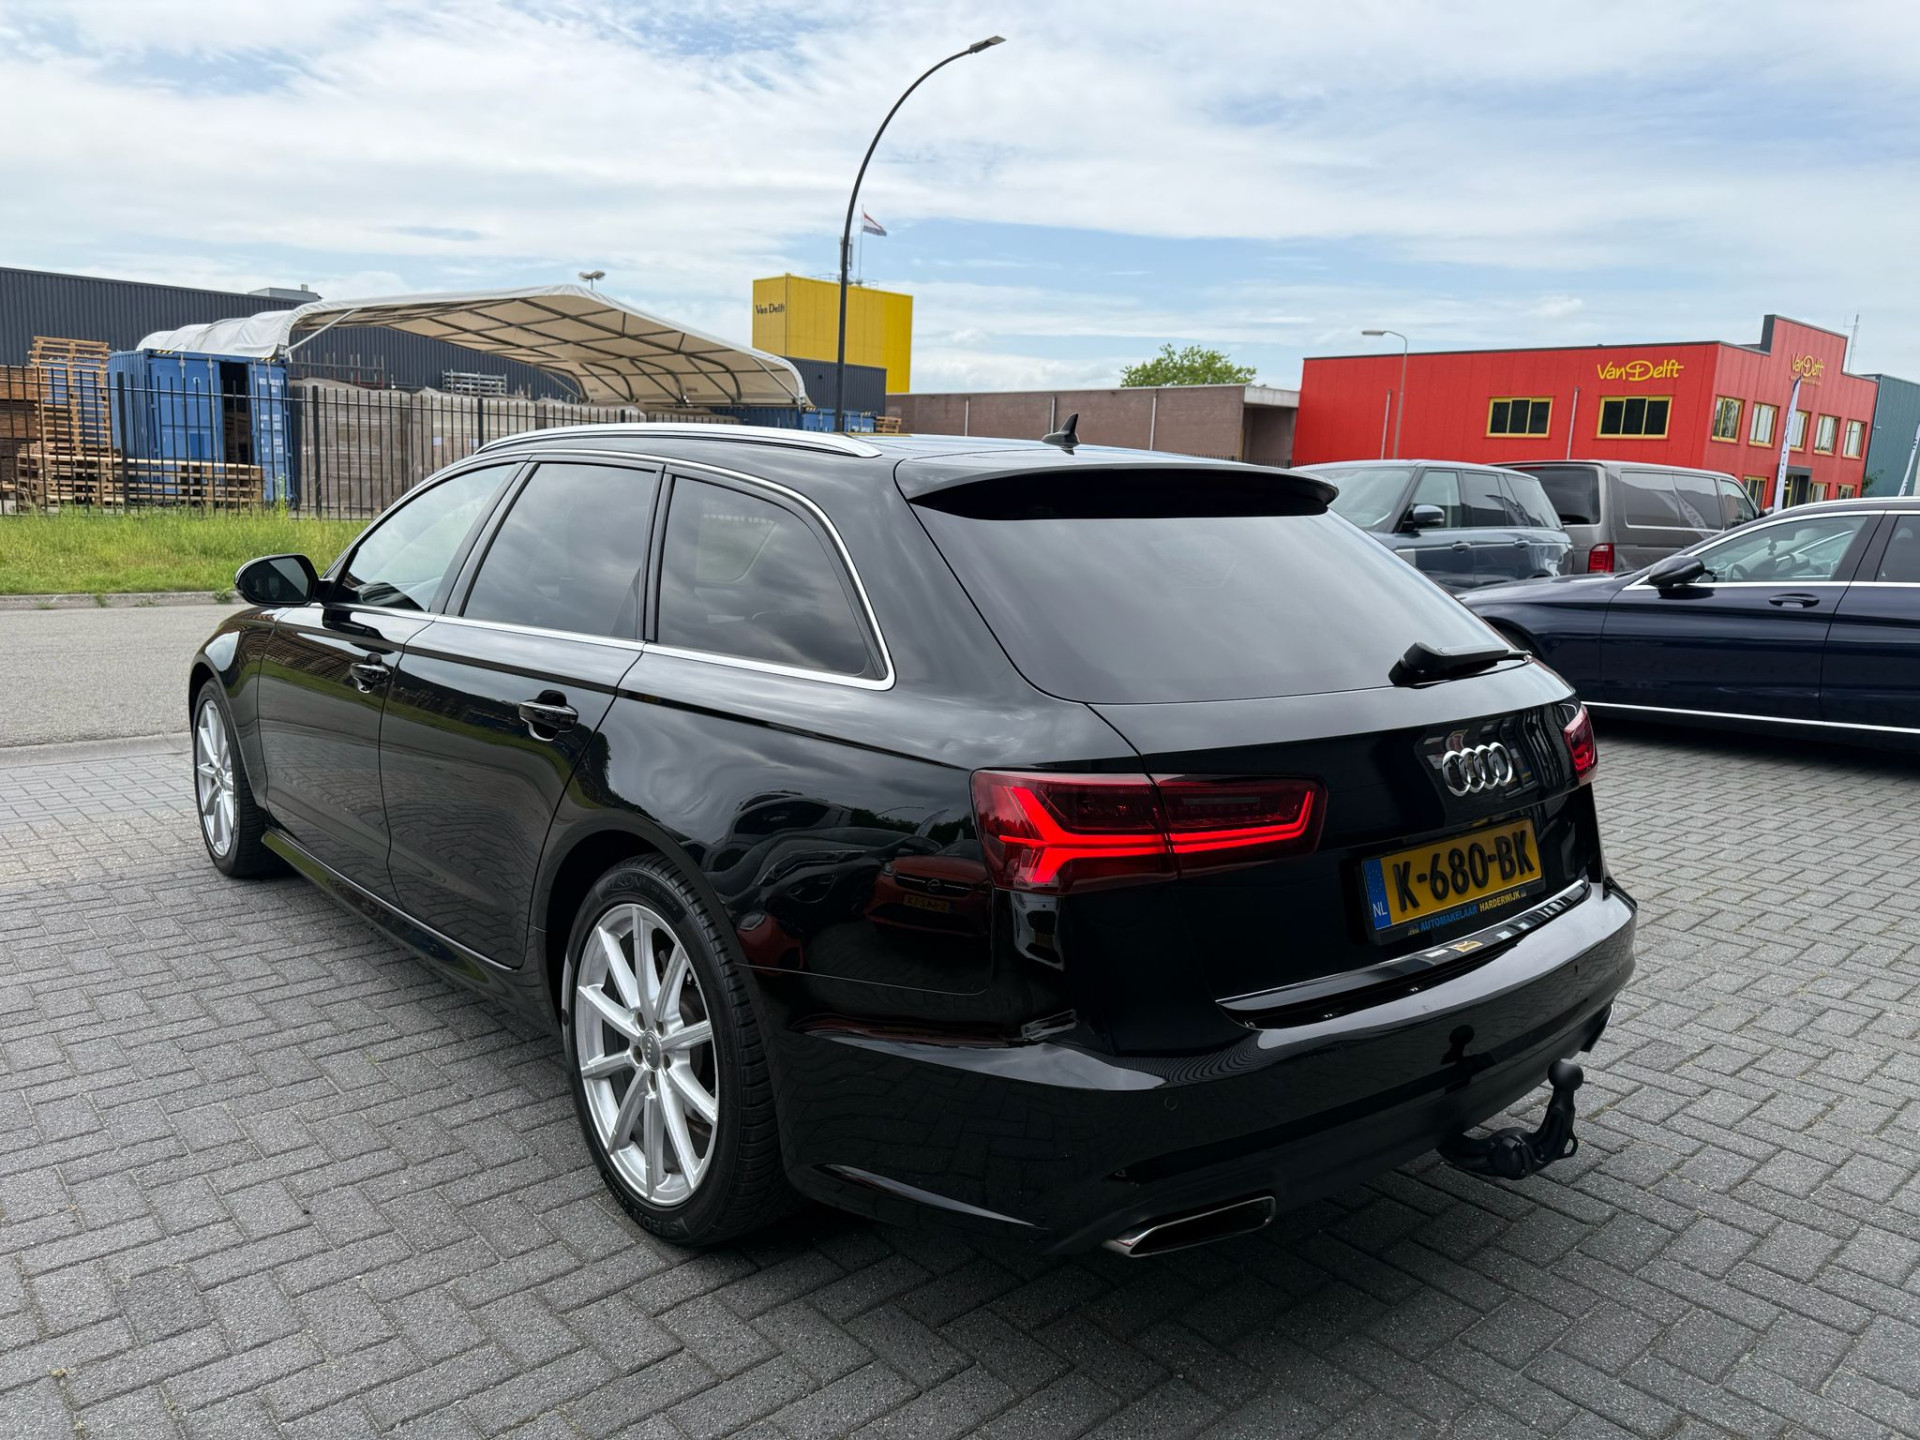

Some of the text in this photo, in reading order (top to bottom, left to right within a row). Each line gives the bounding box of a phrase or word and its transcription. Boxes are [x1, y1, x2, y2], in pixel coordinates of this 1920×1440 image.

[1392, 829, 1535, 913] K-680-BK
[1372, 901, 1388, 918] NL
[1420, 904, 1478, 932] AUTOMAKELAAR
[1479, 890, 1520, 912] HARDERWIJK
